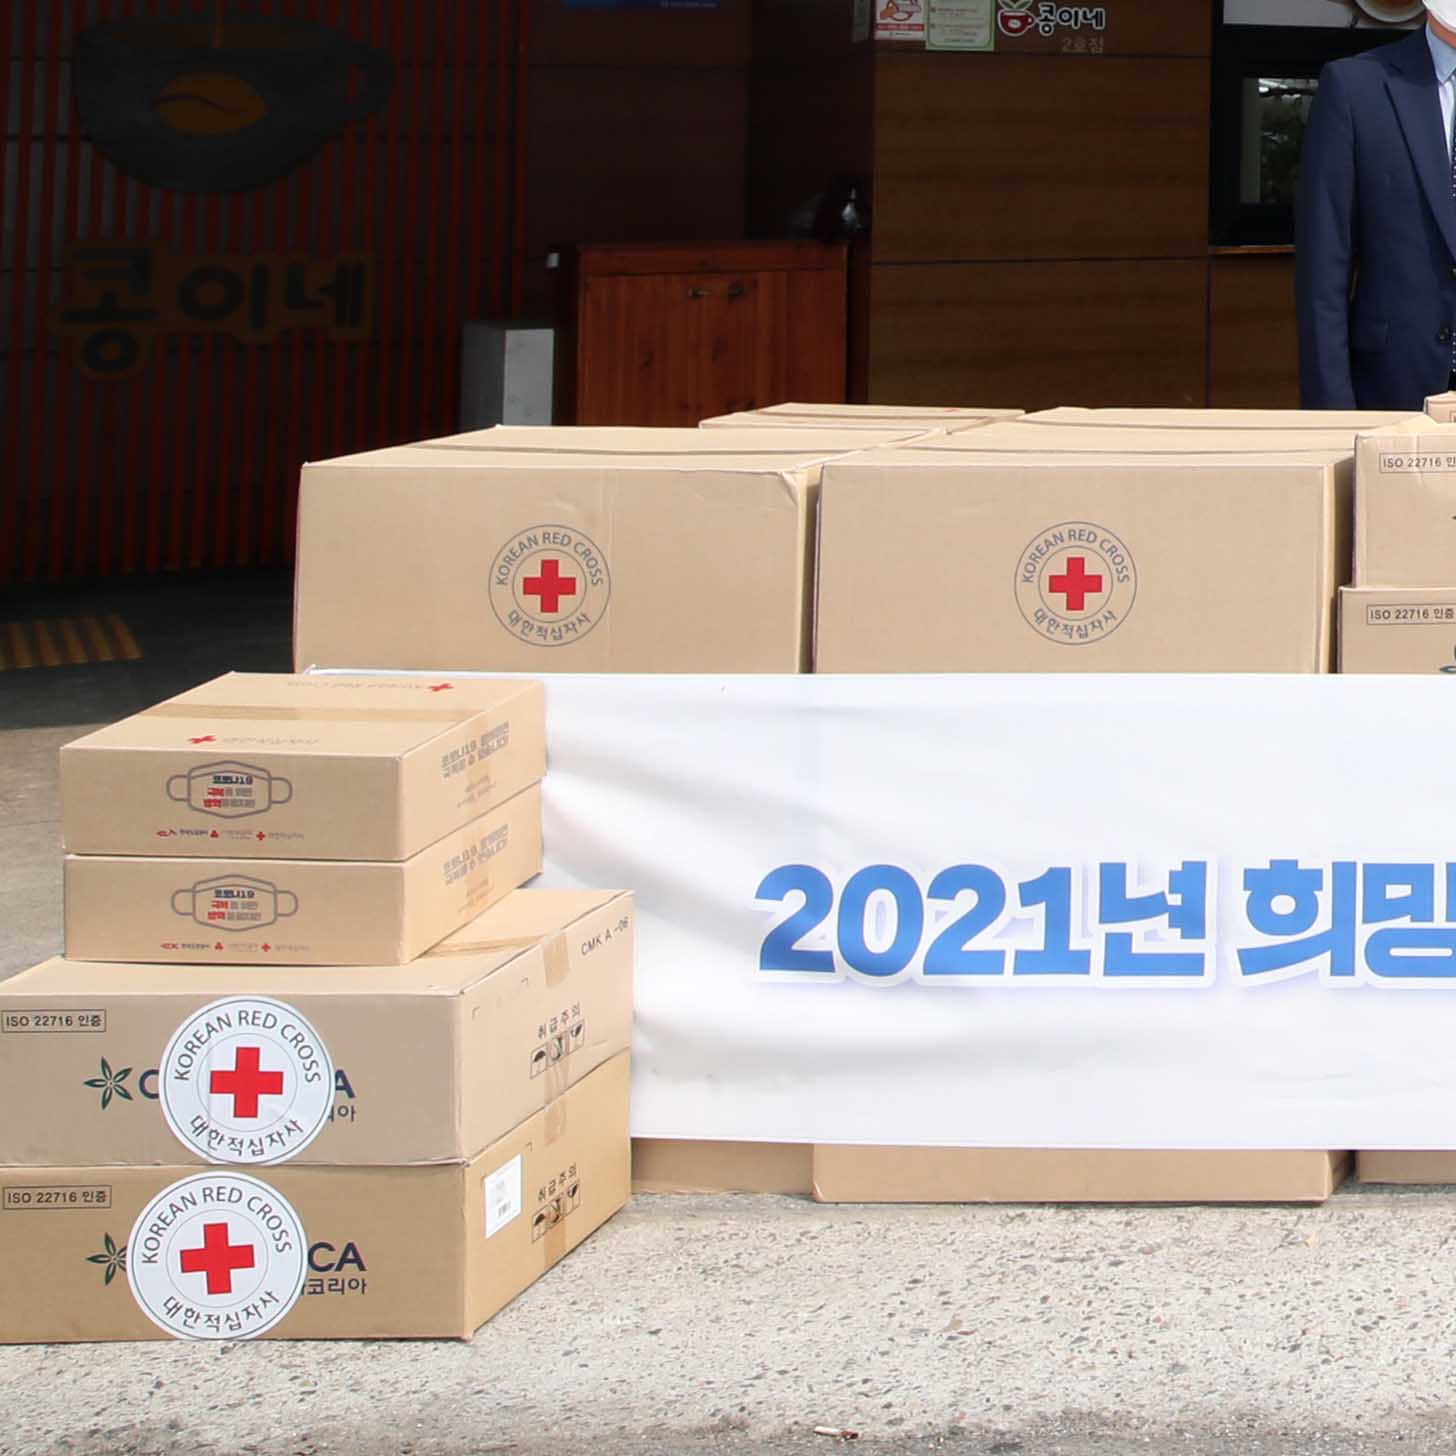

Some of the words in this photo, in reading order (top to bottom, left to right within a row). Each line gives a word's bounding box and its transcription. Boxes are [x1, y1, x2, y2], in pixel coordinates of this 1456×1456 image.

[1038, 2, 1106, 36] 콩이네
[1062, 36, 1104, 54] 2호점
[64, 247, 368, 374] 콩이네
[1383, 457, 1404, 469] ISO
[1407, 457, 1442, 469] 22716
[496, 534, 539, 586] KOREAN
[541, 531, 572, 546] RED
[574, 541, 604, 587] CROSS
[1022, 531, 1065, 584] KOREAN
[1067, 528, 1098, 544] RED
[1099, 538, 1130, 584] CROSS
[508, 609, 592, 641] 대한적십자사
[1033, 607, 1118, 640] 대한적십자사
[1370, 609, 1391, 621] ISO
[1394, 608, 1430, 620] 22716
[1433, 607, 1455, 621] 인증
[753, 860, 1207, 978] 2021년
[580, 937, 602, 956] CMK
[604, 928, 612, 942] A
[6, 1015, 30, 1027] ISO
[34, 1014, 74, 1027] 22716
[78, 1014, 103, 1028] 인증
[174, 1013, 233, 1081] KOREAN
[238, 1009, 278, 1029] RED
[280, 1023, 322, 1083] CROSS
[189, 1114, 304, 1157] 대한적십자사
[7, 1192, 31, 1204] ISO
[36, 1191, 78, 1204] 22716
[82, 1190, 107, 1204] 인증
[141, 1194, 198, 1264] KOREAN
[202, 1185, 243, 1204] RED
[246, 1195, 293, 1254] CROSS
[302, 1278, 368, 1296] 코리아
[162, 1290, 281, 1332] 대한적십자사
